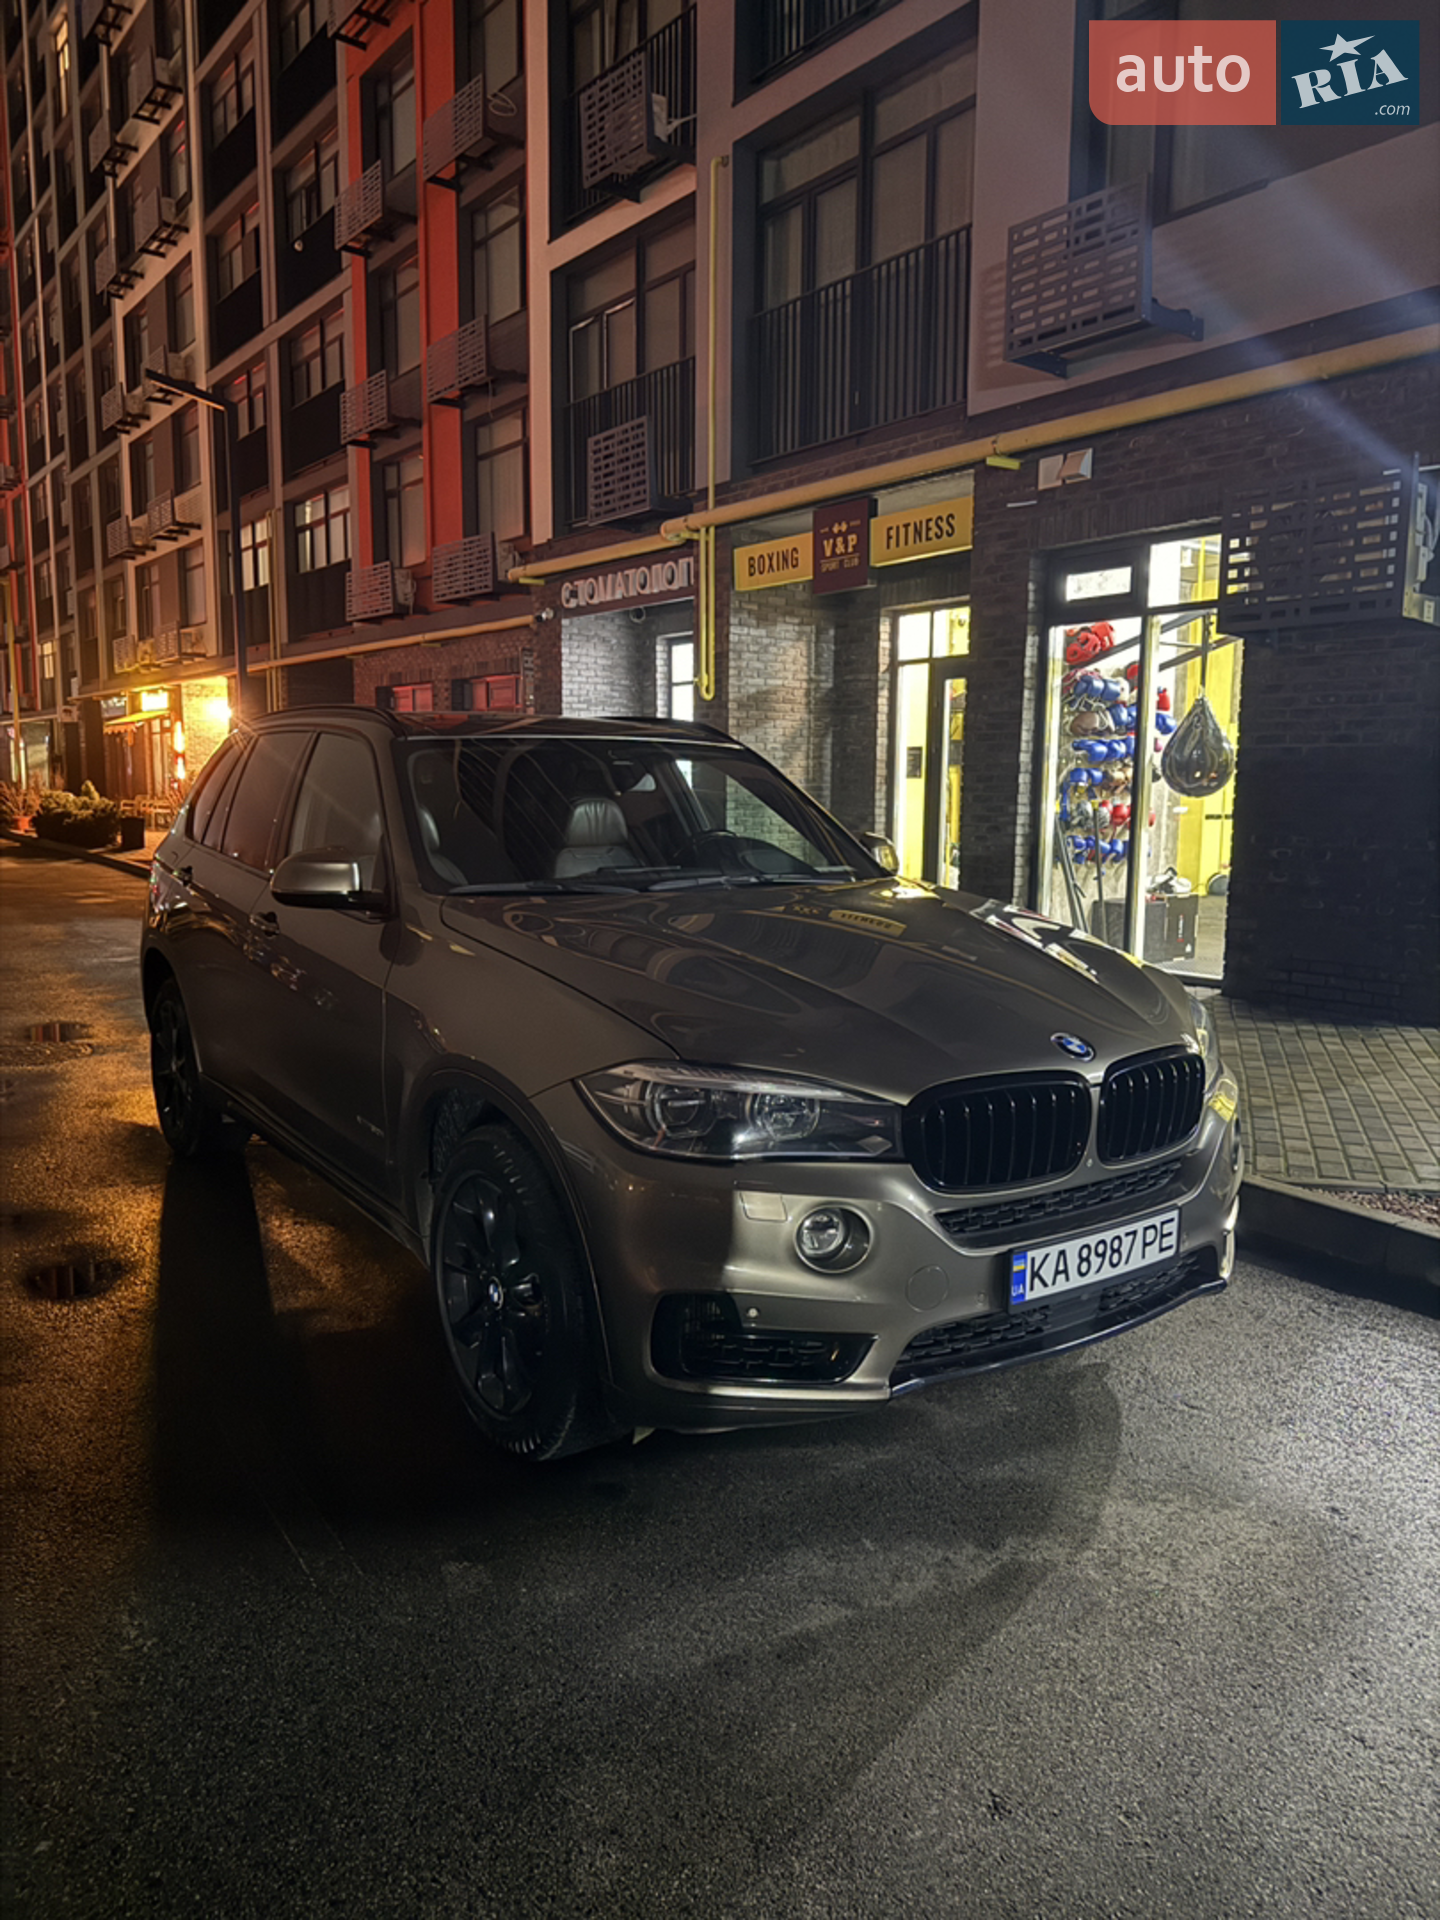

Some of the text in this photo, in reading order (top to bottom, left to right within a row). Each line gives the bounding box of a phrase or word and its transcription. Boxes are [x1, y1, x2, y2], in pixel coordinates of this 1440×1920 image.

[824, 534, 858, 557] V&P
[886, 513, 956, 550] FITNESS
[747, 546, 800, 577] BOXING
[1076, 1230, 1139, 1278] 8987
